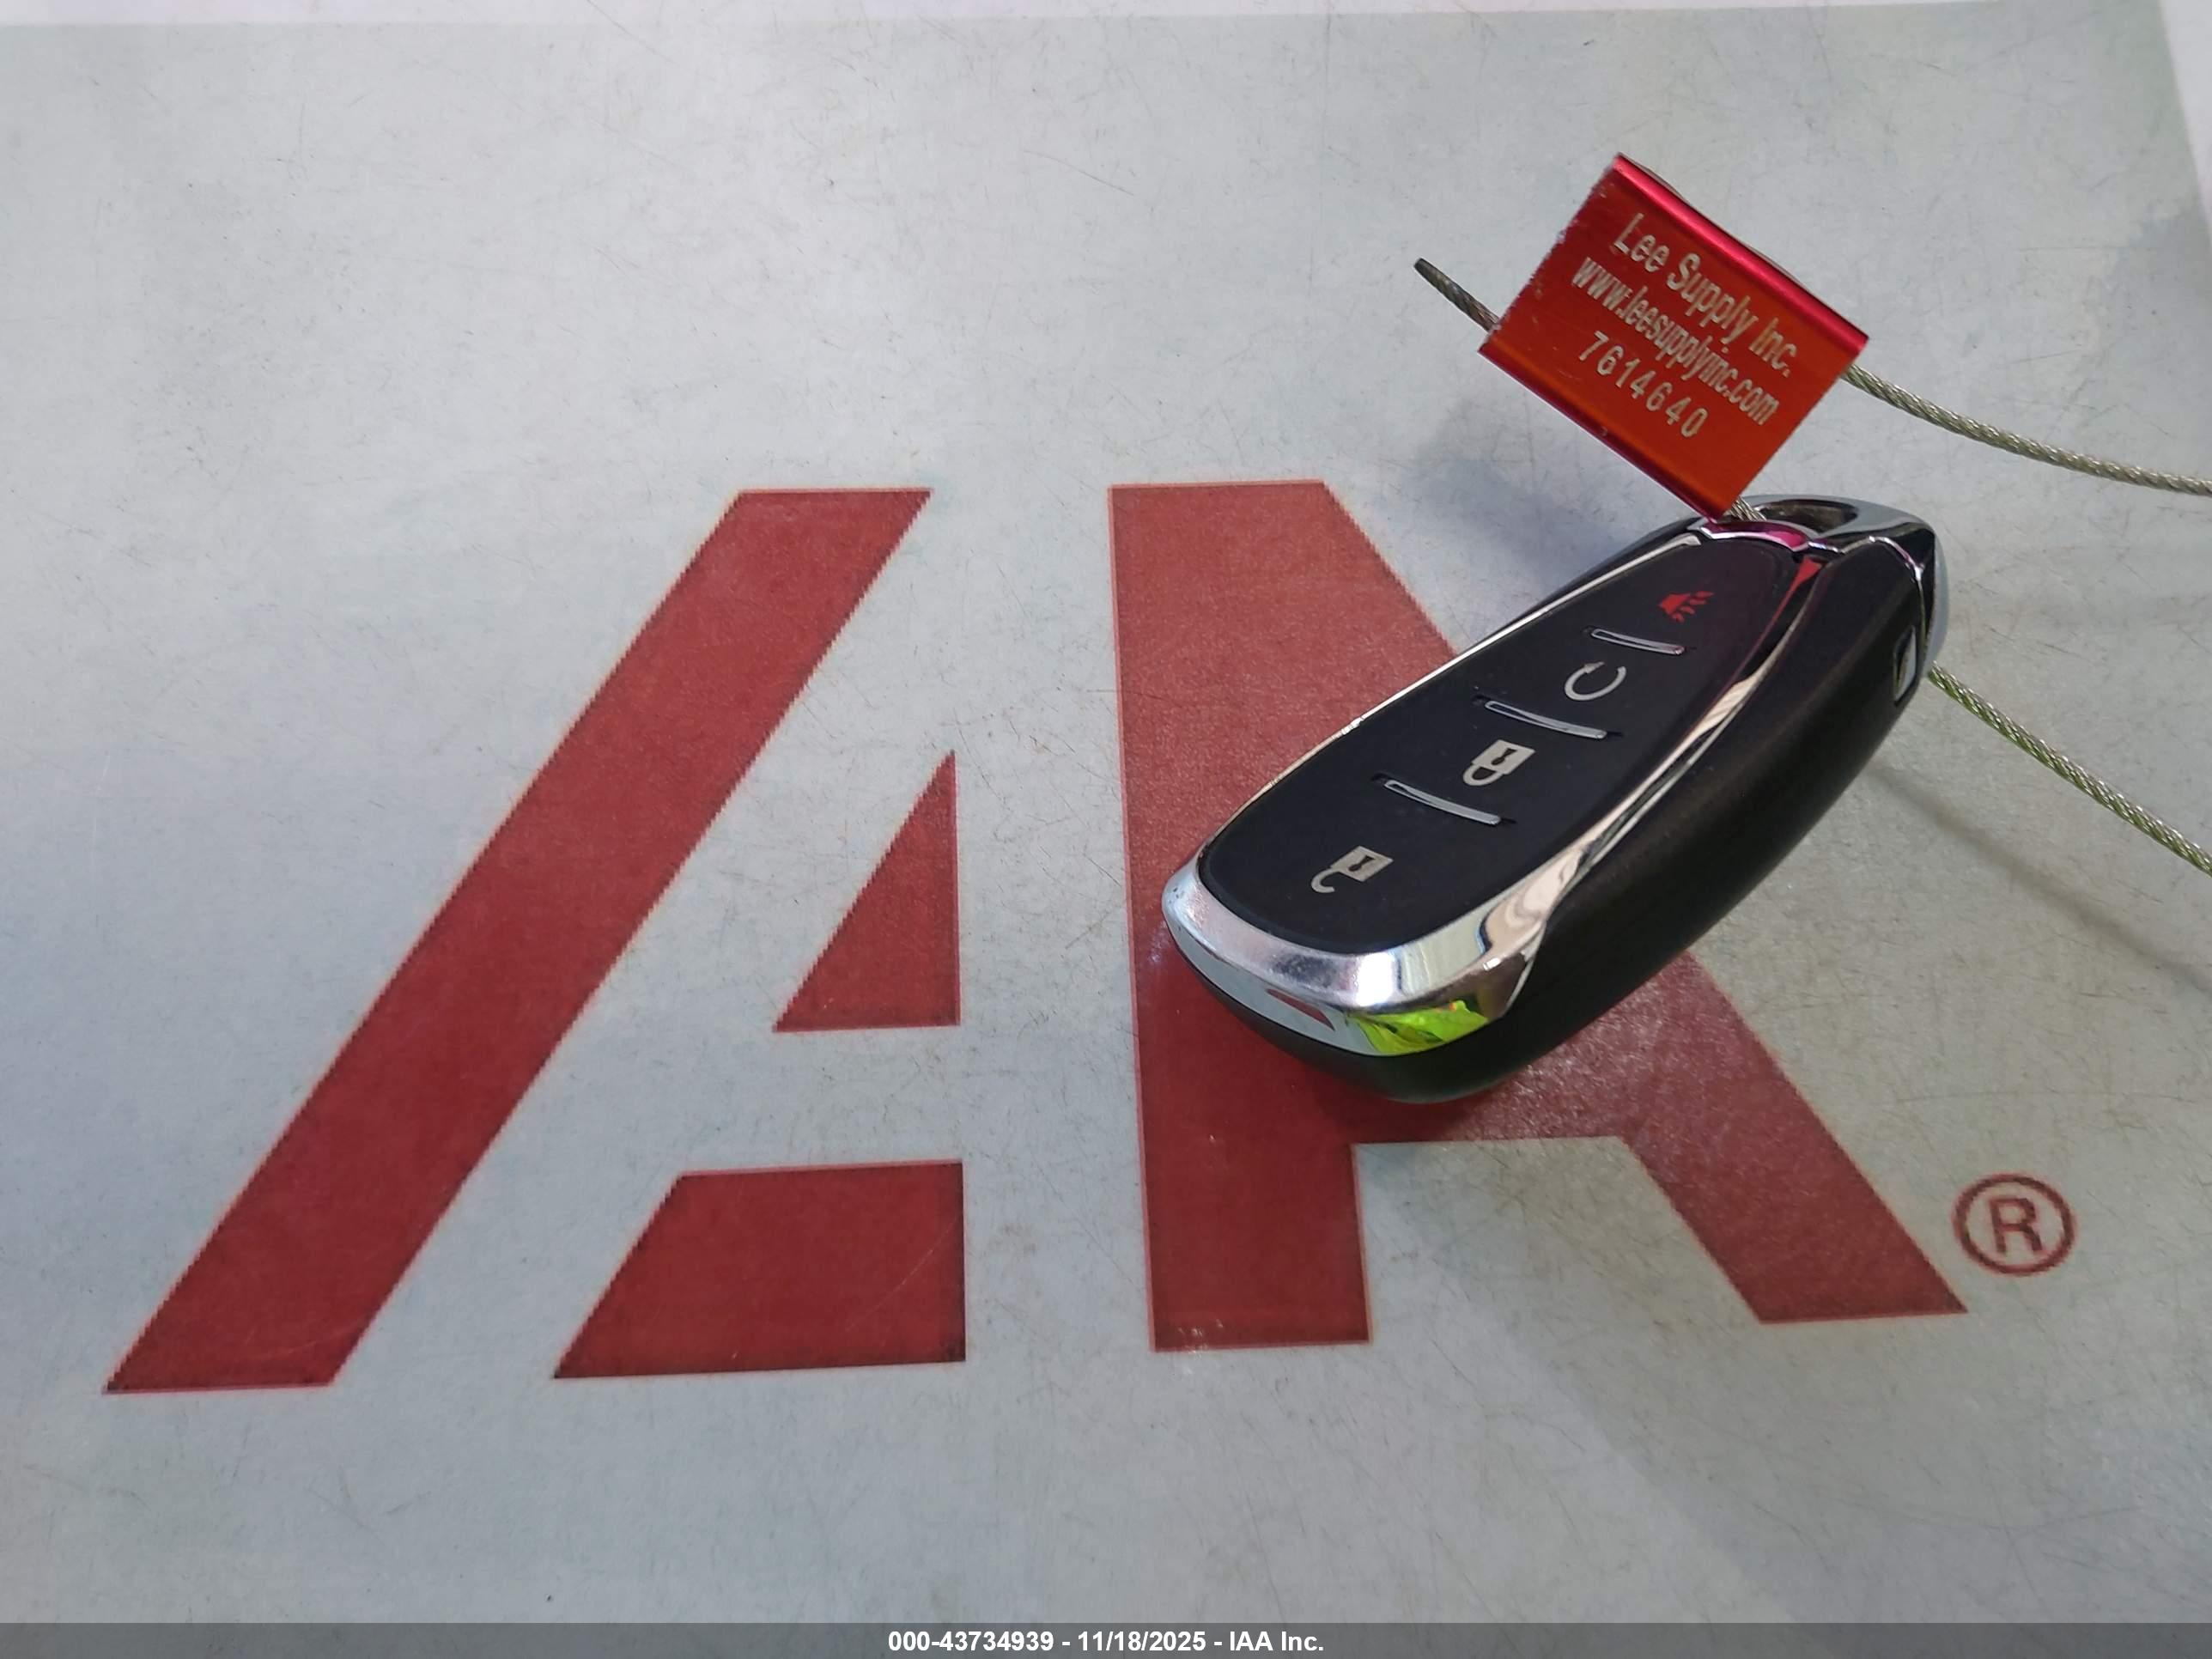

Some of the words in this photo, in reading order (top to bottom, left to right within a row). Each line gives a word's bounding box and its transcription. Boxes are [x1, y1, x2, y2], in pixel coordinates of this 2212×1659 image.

[1571, 256, 1780, 426] www.leesupplyinc.com
[1613, 212, 1670, 272] Lee
[1666, 252, 1759, 345] Supply
[1747, 317, 1798, 379] Inc.
[1578, 330, 1709, 438] 7614640
